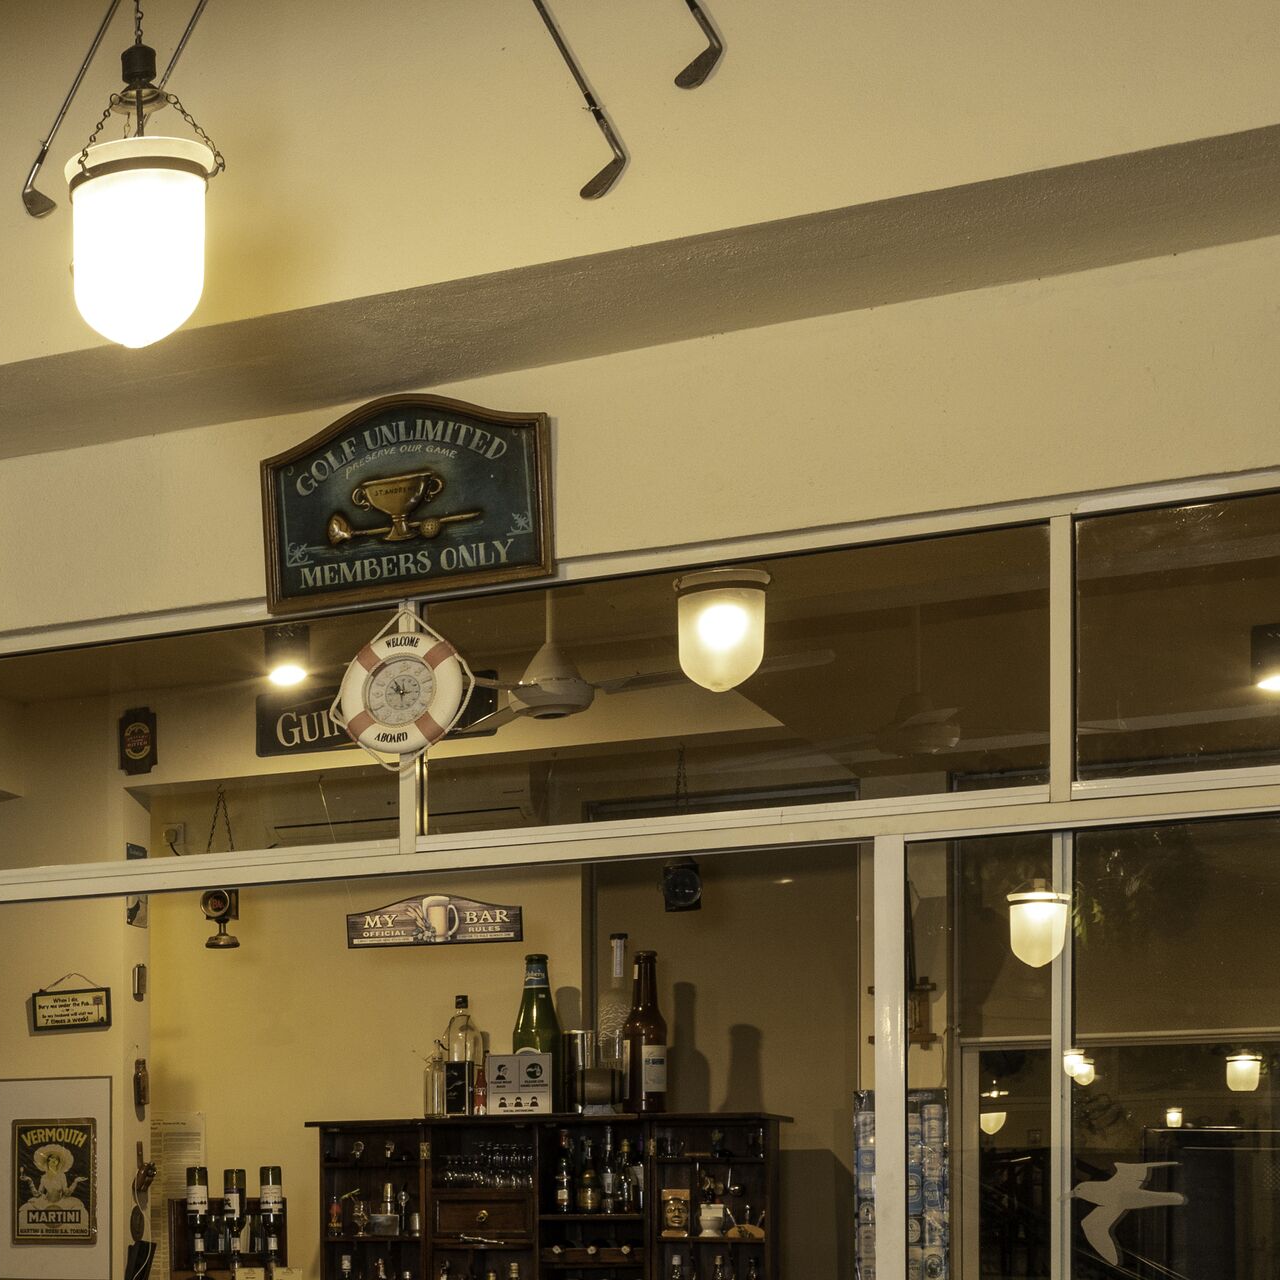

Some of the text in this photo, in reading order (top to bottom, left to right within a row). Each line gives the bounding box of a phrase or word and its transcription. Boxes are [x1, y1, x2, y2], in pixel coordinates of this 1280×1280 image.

[295, 419, 508, 497] GOLF UNLIMITED
[345, 444, 458, 480] PRESERVE OUR GAME
[299, 538, 515, 589] MEMBERS ONLY
[385, 635, 420, 649] WELCOME
[276, 709, 341, 747] GUI
[374, 731, 409, 743] ABOARD
[363, 909, 511, 929] MY BAR
[362, 925, 501, 938] OFFICIAL RULES
[21, 1127, 88, 1148] VERMOUTH
[28, 1211, 79, 1223] MARTINI
